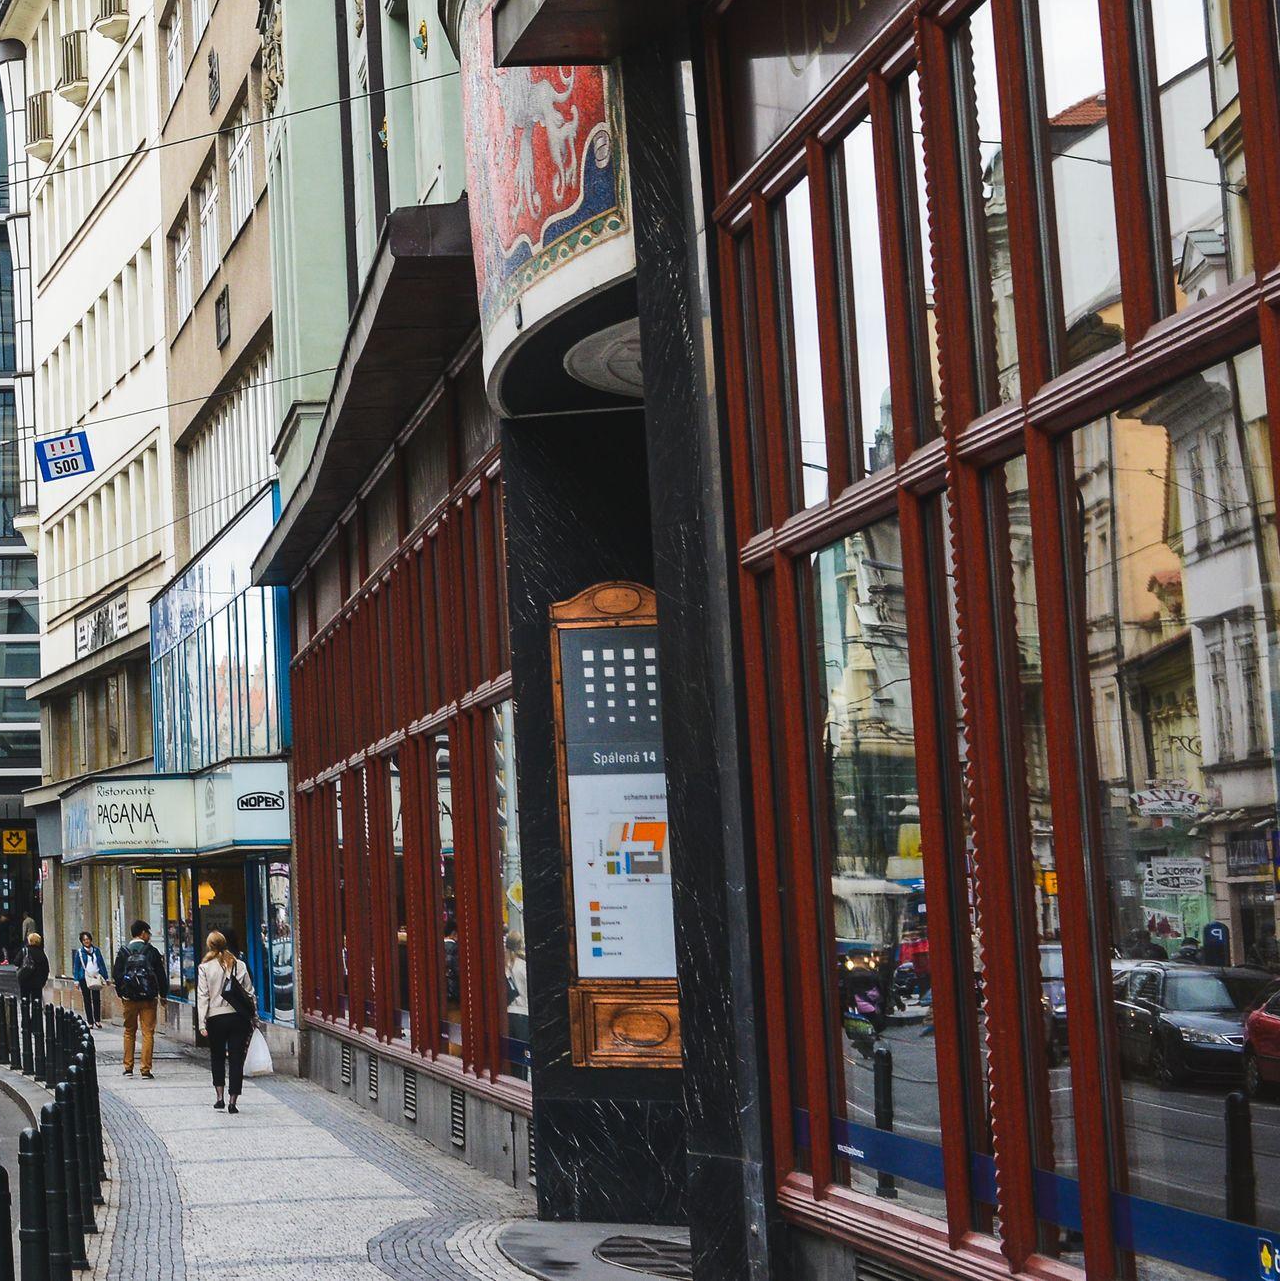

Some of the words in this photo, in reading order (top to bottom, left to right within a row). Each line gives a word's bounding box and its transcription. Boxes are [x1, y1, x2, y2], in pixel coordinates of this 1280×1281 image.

[53, 457, 80, 475] 500
[593, 751, 640, 766] Spálená
[642, 751, 657, 763] 14
[96, 785, 157, 797] Ristorante
[241, 797, 281, 808] NOPEK
[97, 802, 159, 834] PAGANA
